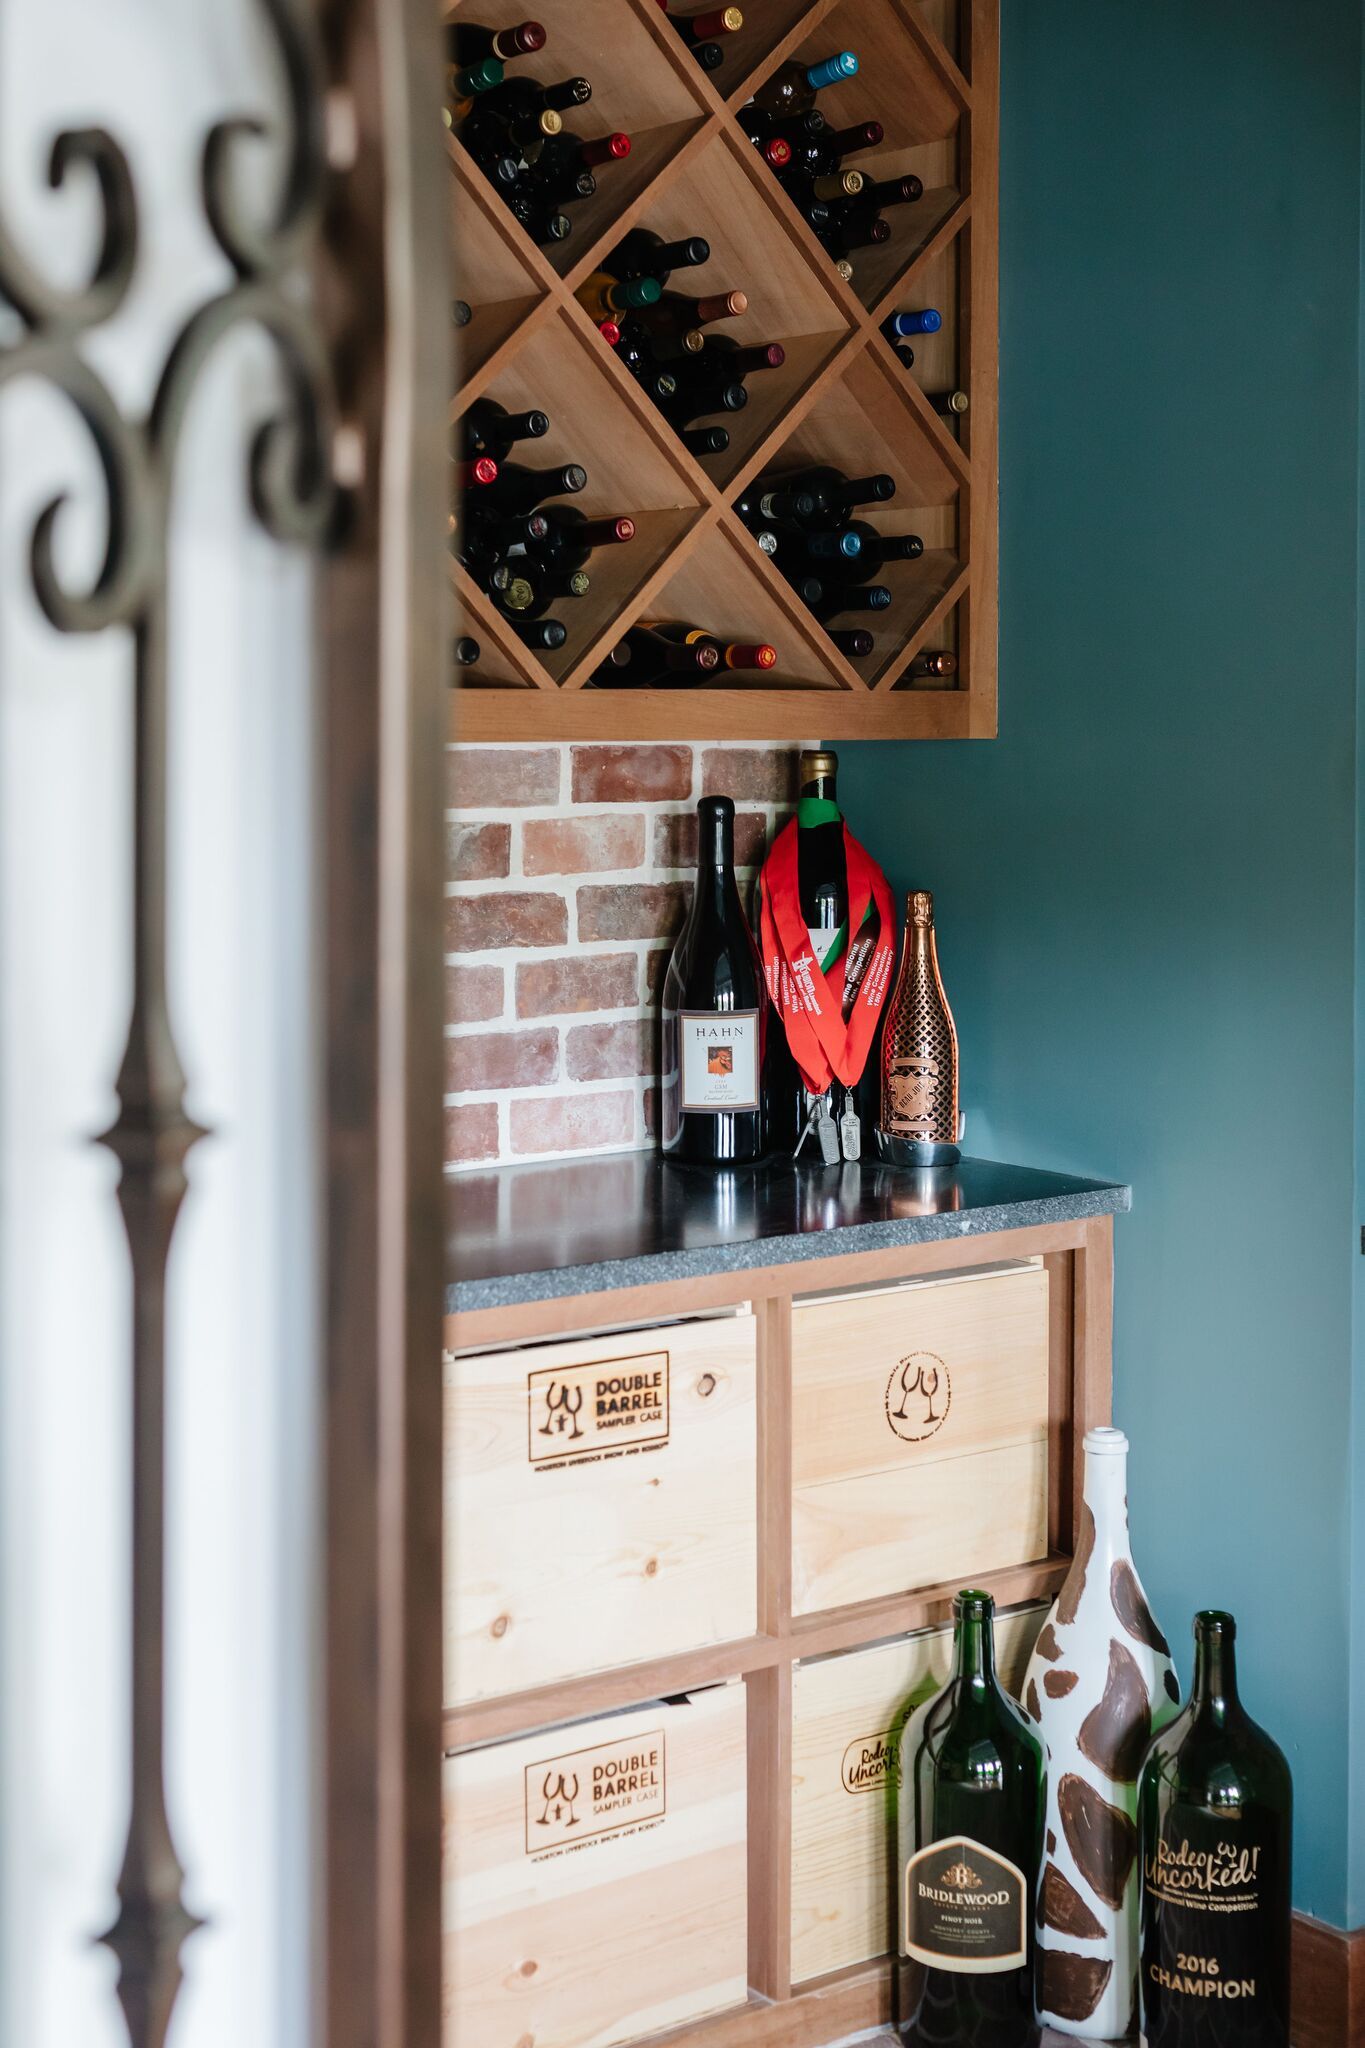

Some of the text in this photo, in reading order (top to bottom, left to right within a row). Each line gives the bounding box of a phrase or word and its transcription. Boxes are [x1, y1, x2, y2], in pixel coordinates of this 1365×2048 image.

[848, 938, 871, 983] Competition
[862, 951, 881, 995] International
[867, 945, 889, 1006] Wine Competition
[874, 949, 894, 1007] 15th Anniversary
[696, 1026, 744, 1037] HAHN
[596, 1371, 662, 1398] DOUBLE
[596, 1391, 663, 1417] BARREL
[596, 1410, 663, 1431] SAMPLER CASE
[592, 1750, 658, 1783] DOUBLE
[861, 1741, 890, 1767] Rodeo
[849, 1757, 897, 1785] Uncork
[592, 1770, 659, 1802] BARREL
[592, 1789, 659, 1816] SAMPLER CASE
[1157, 1838, 1207, 1867] Rodeo
[956, 1867, 967, 1884] B
[1145, 1847, 1258, 1893] Uncorked!
[918, 1882, 1010, 1906] BRIDLEWOOD
[1185, 1899, 1207, 1910] Wine
[1208, 1902, 1258, 1914] Competition
[941, 1914, 983, 1925] PINOT NOIR
[1176, 1953, 1220, 1976] 2016
[1150, 1964, 1256, 1999] CHAMPION
